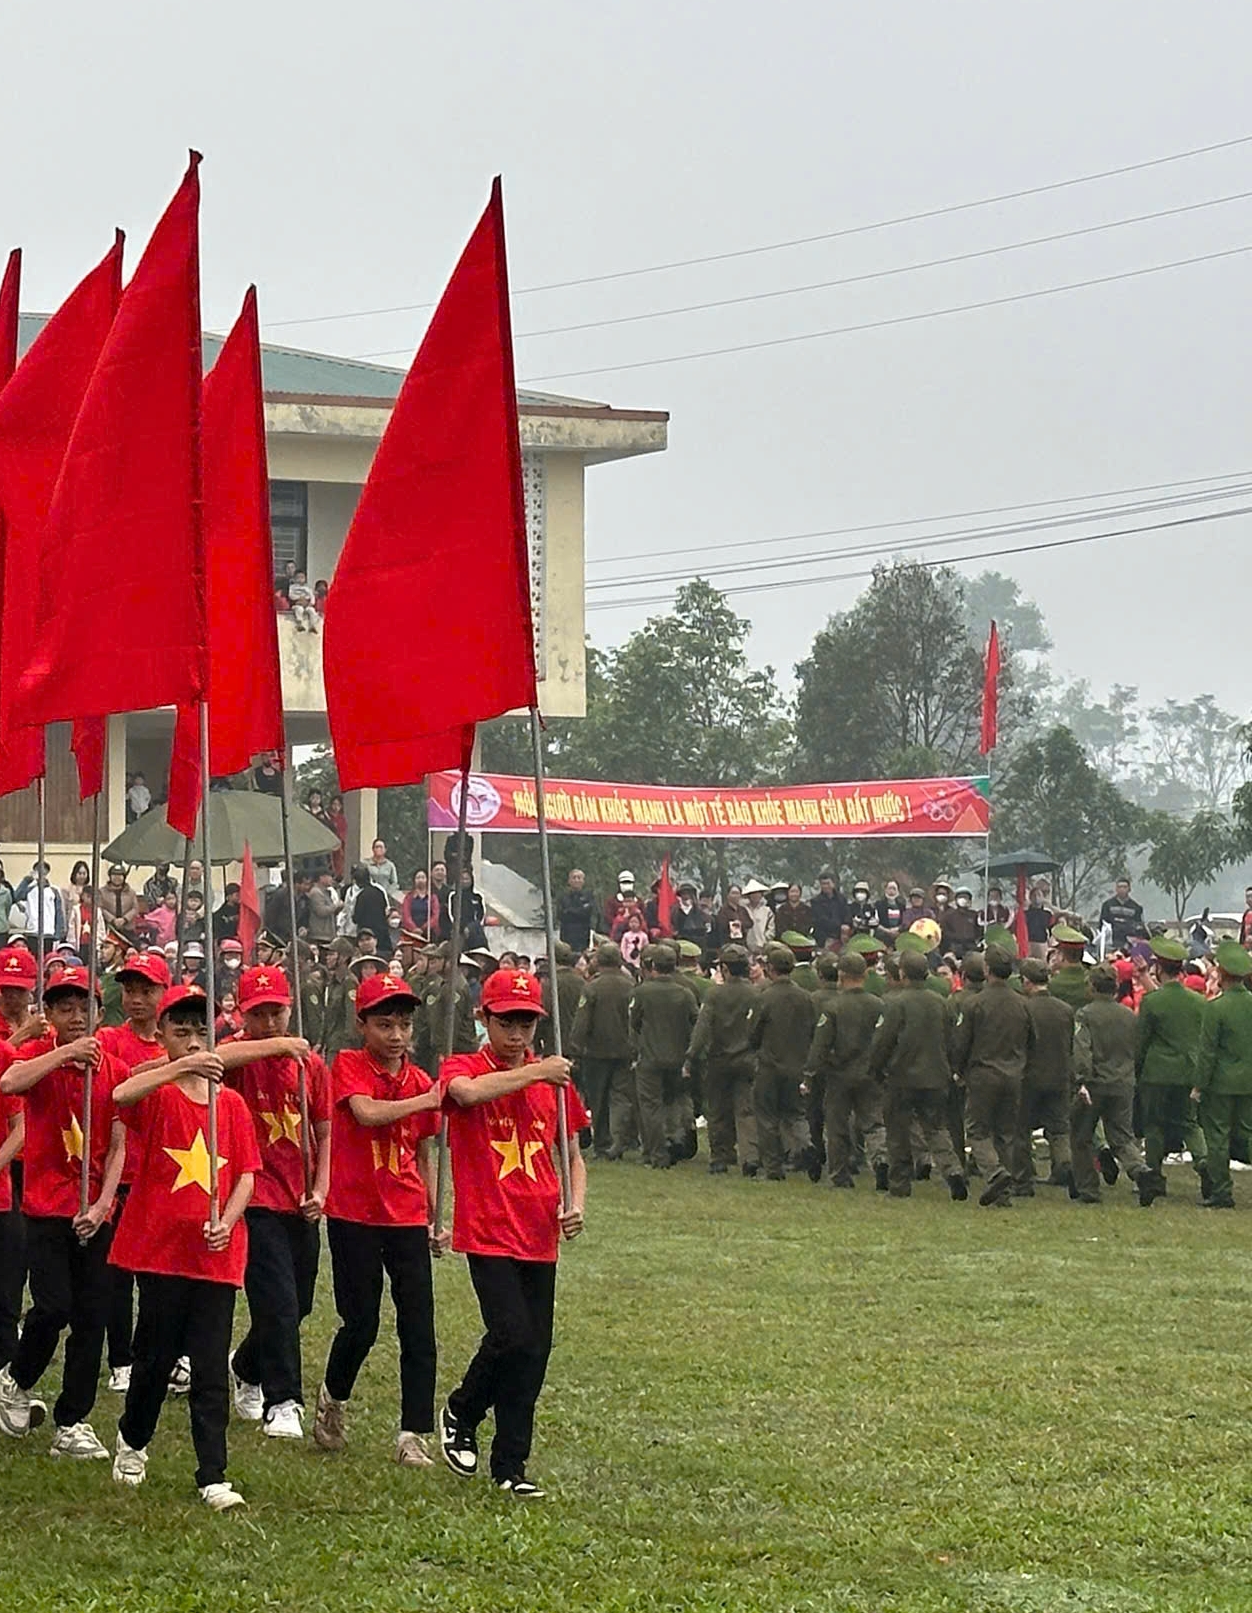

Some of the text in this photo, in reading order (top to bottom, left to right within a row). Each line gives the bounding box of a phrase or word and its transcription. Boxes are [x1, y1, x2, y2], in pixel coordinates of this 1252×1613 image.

[666, 795, 684, 826] LÀ
[682, 796, 710, 831] MỘT
[708, 793, 727, 826] TẾ
[820, 788, 847, 825] CỦA
